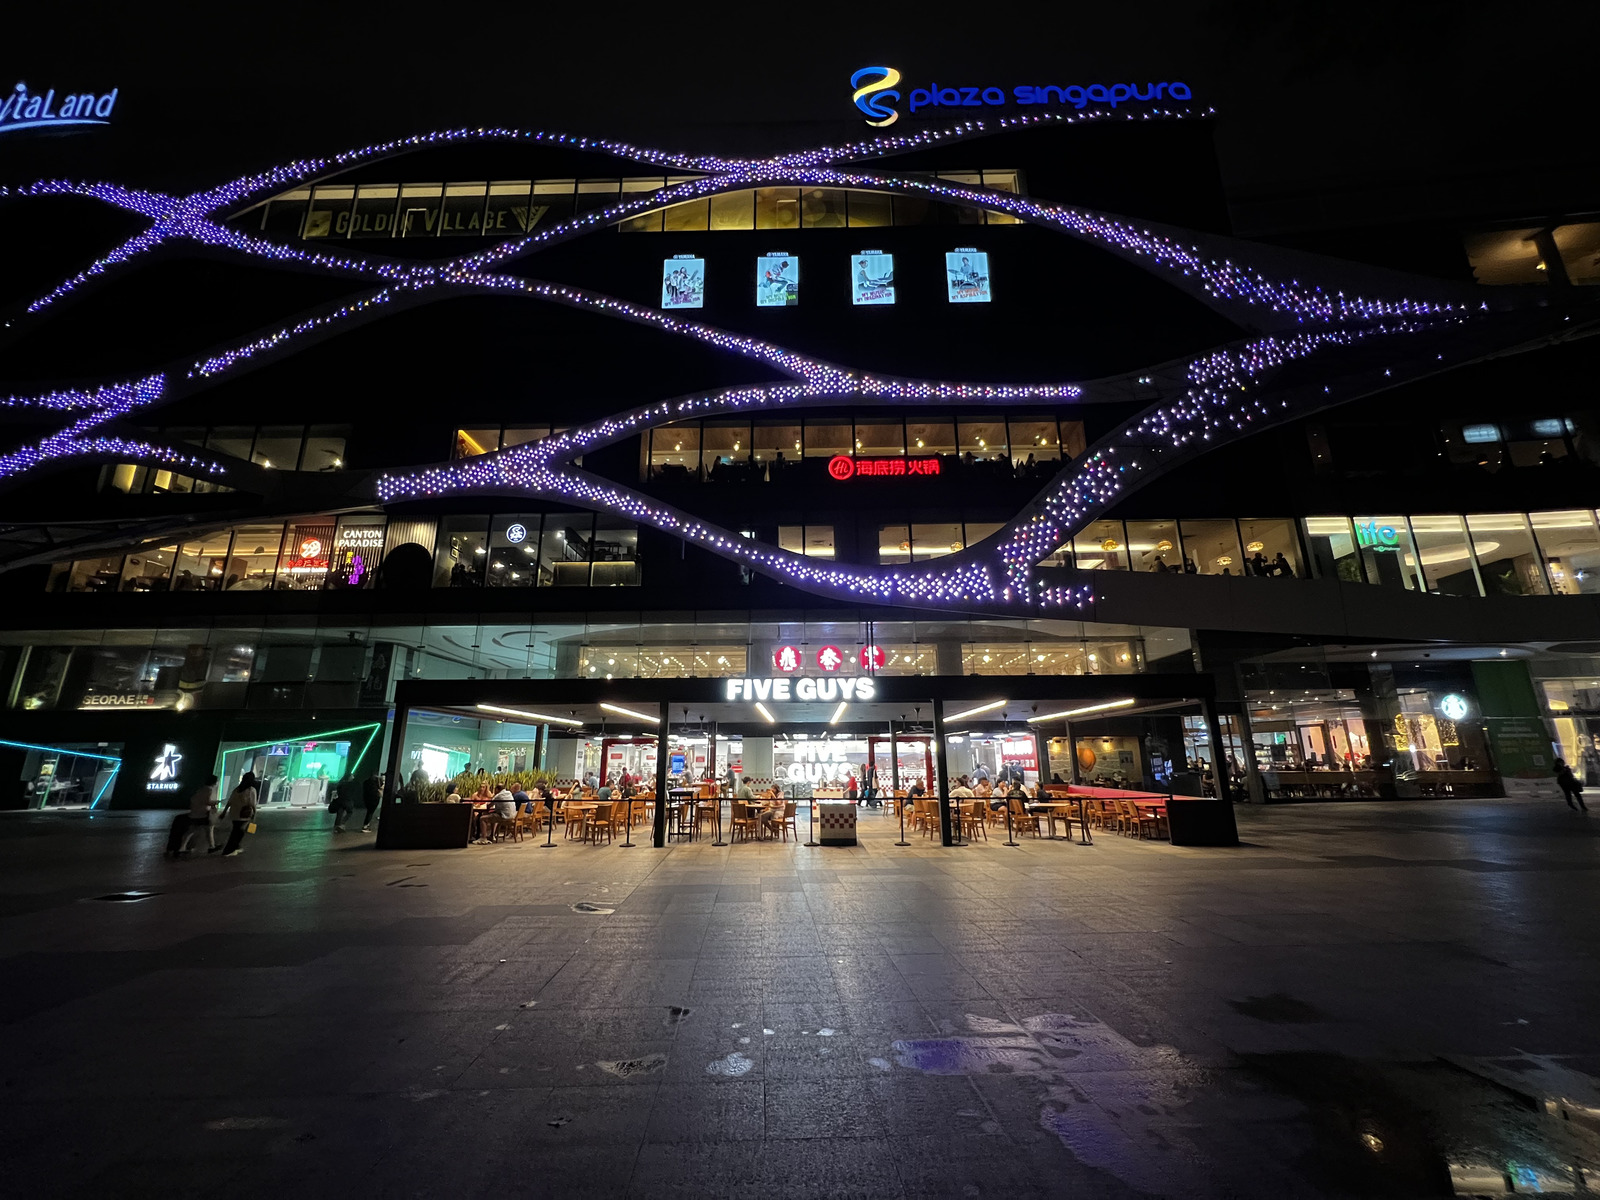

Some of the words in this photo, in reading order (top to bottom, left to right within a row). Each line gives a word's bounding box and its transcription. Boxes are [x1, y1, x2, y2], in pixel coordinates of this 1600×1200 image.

[0, 83, 118, 119] itaLand
[910, 83, 1005, 112] plaza
[1013, 82, 1192, 108] singapura
[425, 209, 508, 232] VLLAGE
[339, 540, 384, 548] PARADISE
[343, 530, 383, 539] CANTON
[1355, 521, 1399, 545] life
[83, 694, 136, 705] SEORAE
[727, 678, 791, 701] FIVE
[796, 677, 876, 701] GUYS
[794, 741, 848, 762] FIVE
[787, 762, 853, 786] GUYS
